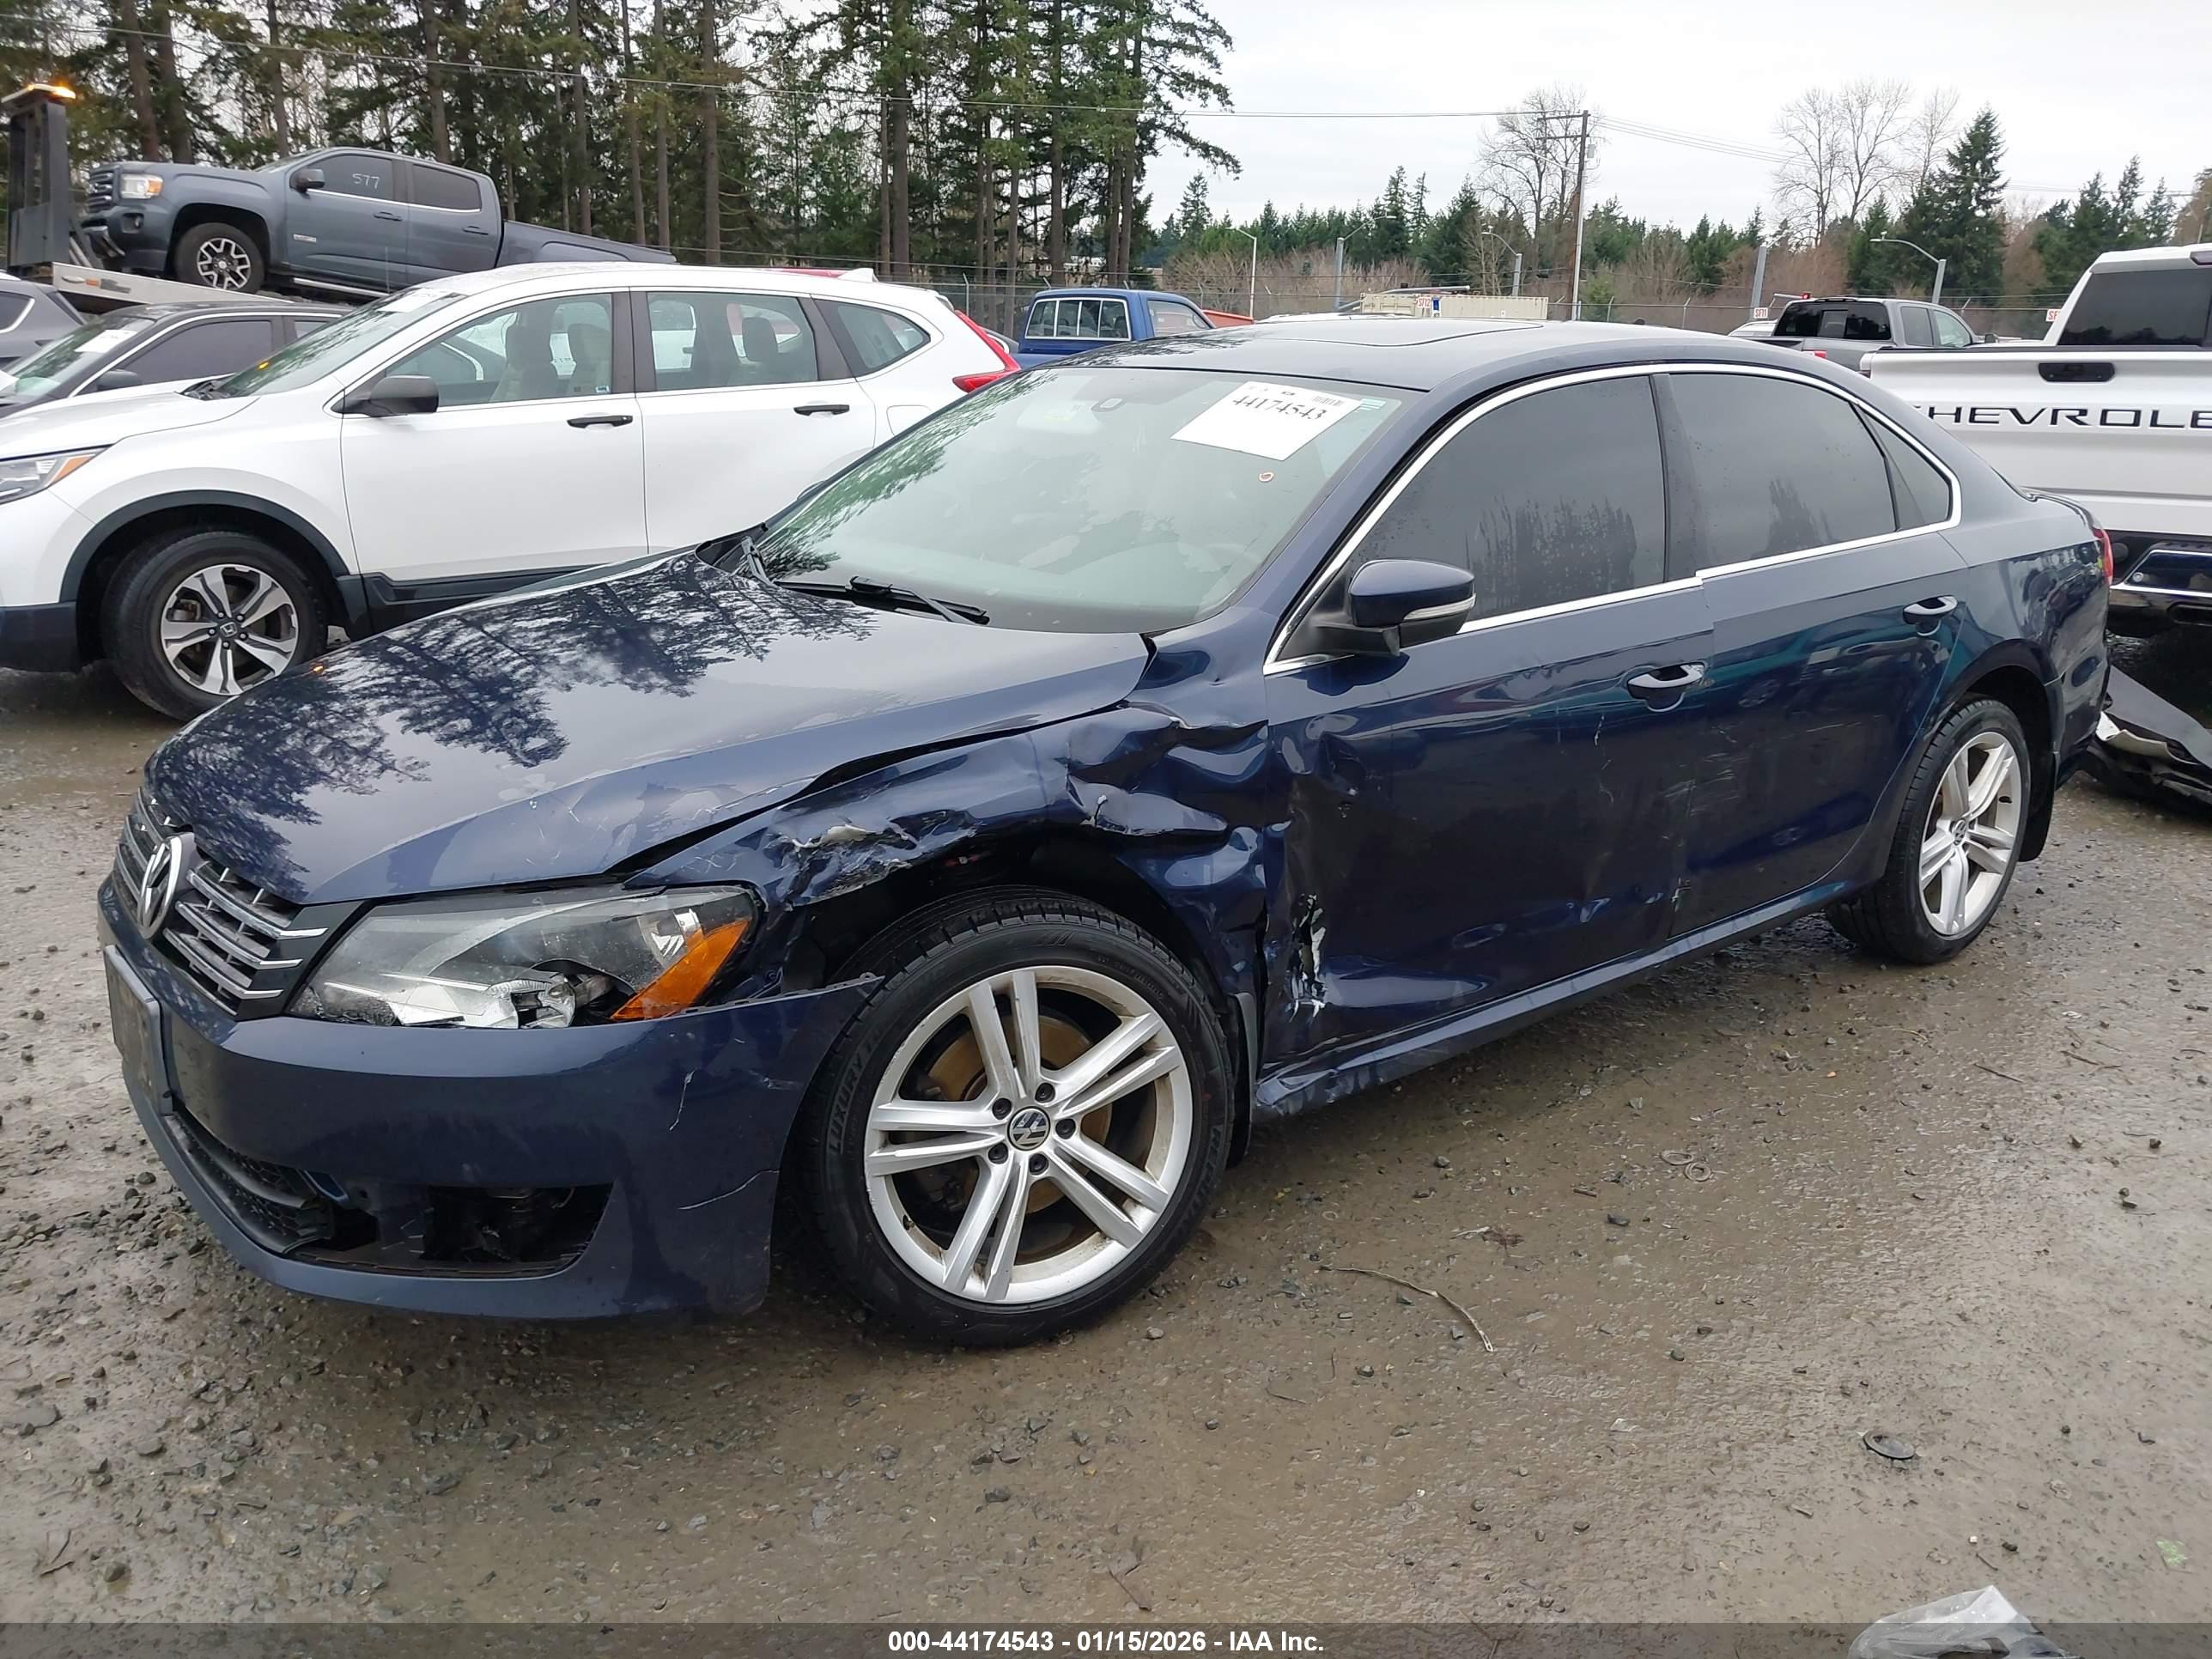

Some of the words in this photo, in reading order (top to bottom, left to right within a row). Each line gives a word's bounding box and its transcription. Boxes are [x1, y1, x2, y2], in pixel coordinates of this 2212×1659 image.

[352, 173, 380, 190] 577
[2048, 310, 2061, 320] SF
[1232, 395, 1328, 420] 44174543
[1913, 404, 2212, 428] HEVROLE
